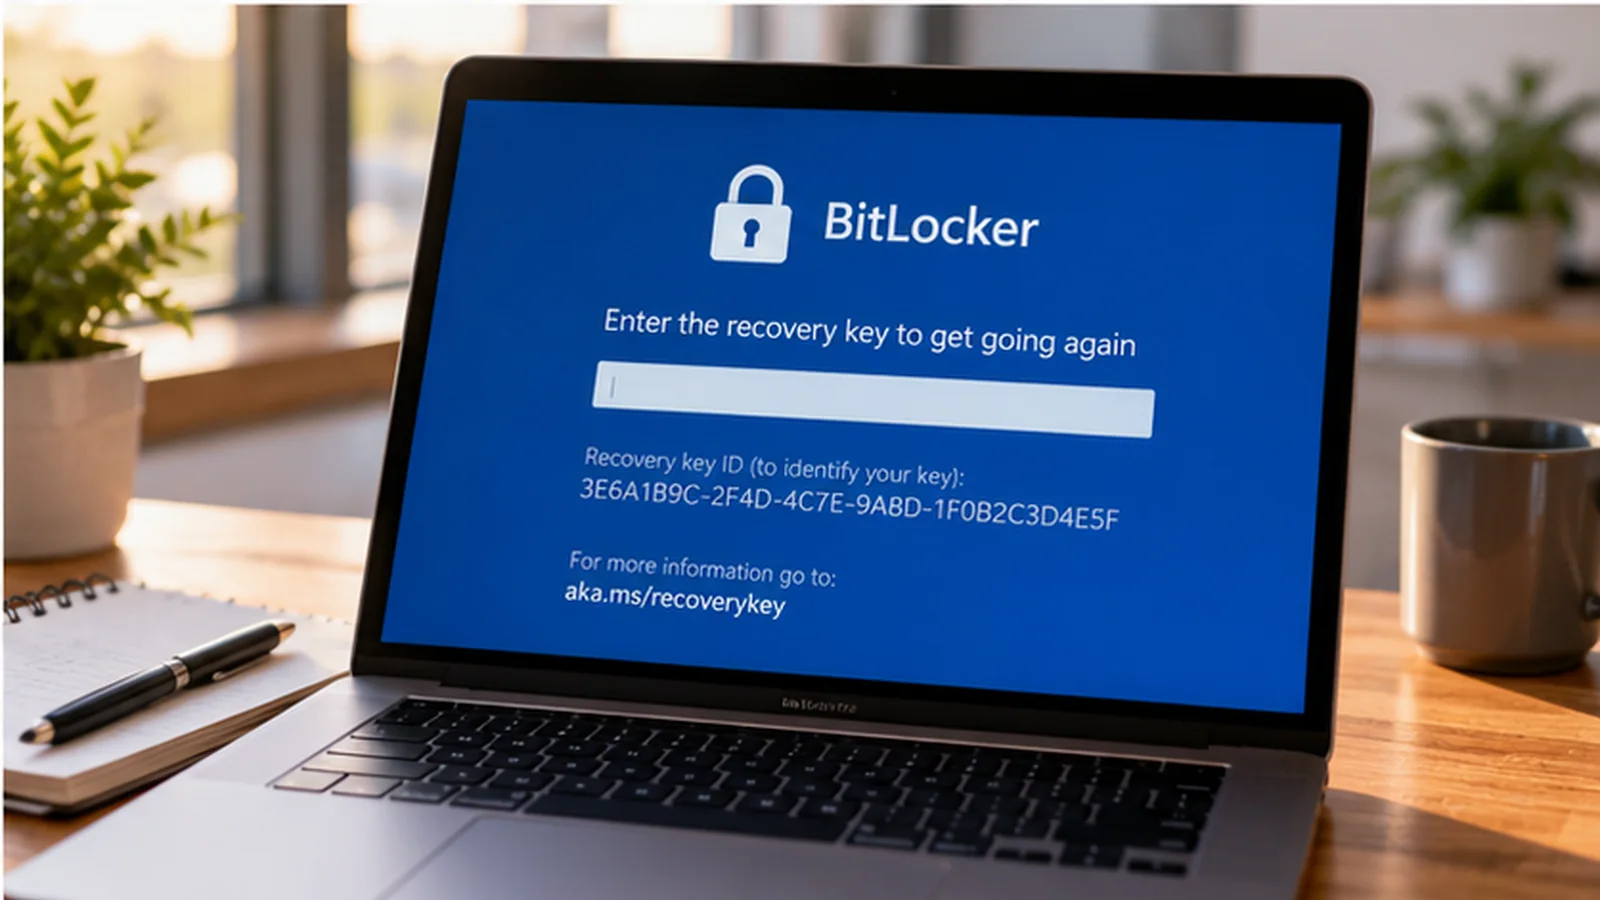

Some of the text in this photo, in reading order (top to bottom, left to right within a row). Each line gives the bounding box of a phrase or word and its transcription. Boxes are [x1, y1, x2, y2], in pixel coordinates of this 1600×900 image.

[824, 201, 1040, 249] BitLocker
[604, 307, 1137, 362] Enter the recovery key to get going again
[585, 446, 965, 490] Recovery key ID (to identify your key):
[569, 550, 837, 589] For more information go to:
[564, 580, 787, 621] aka.ms/recoverykey
